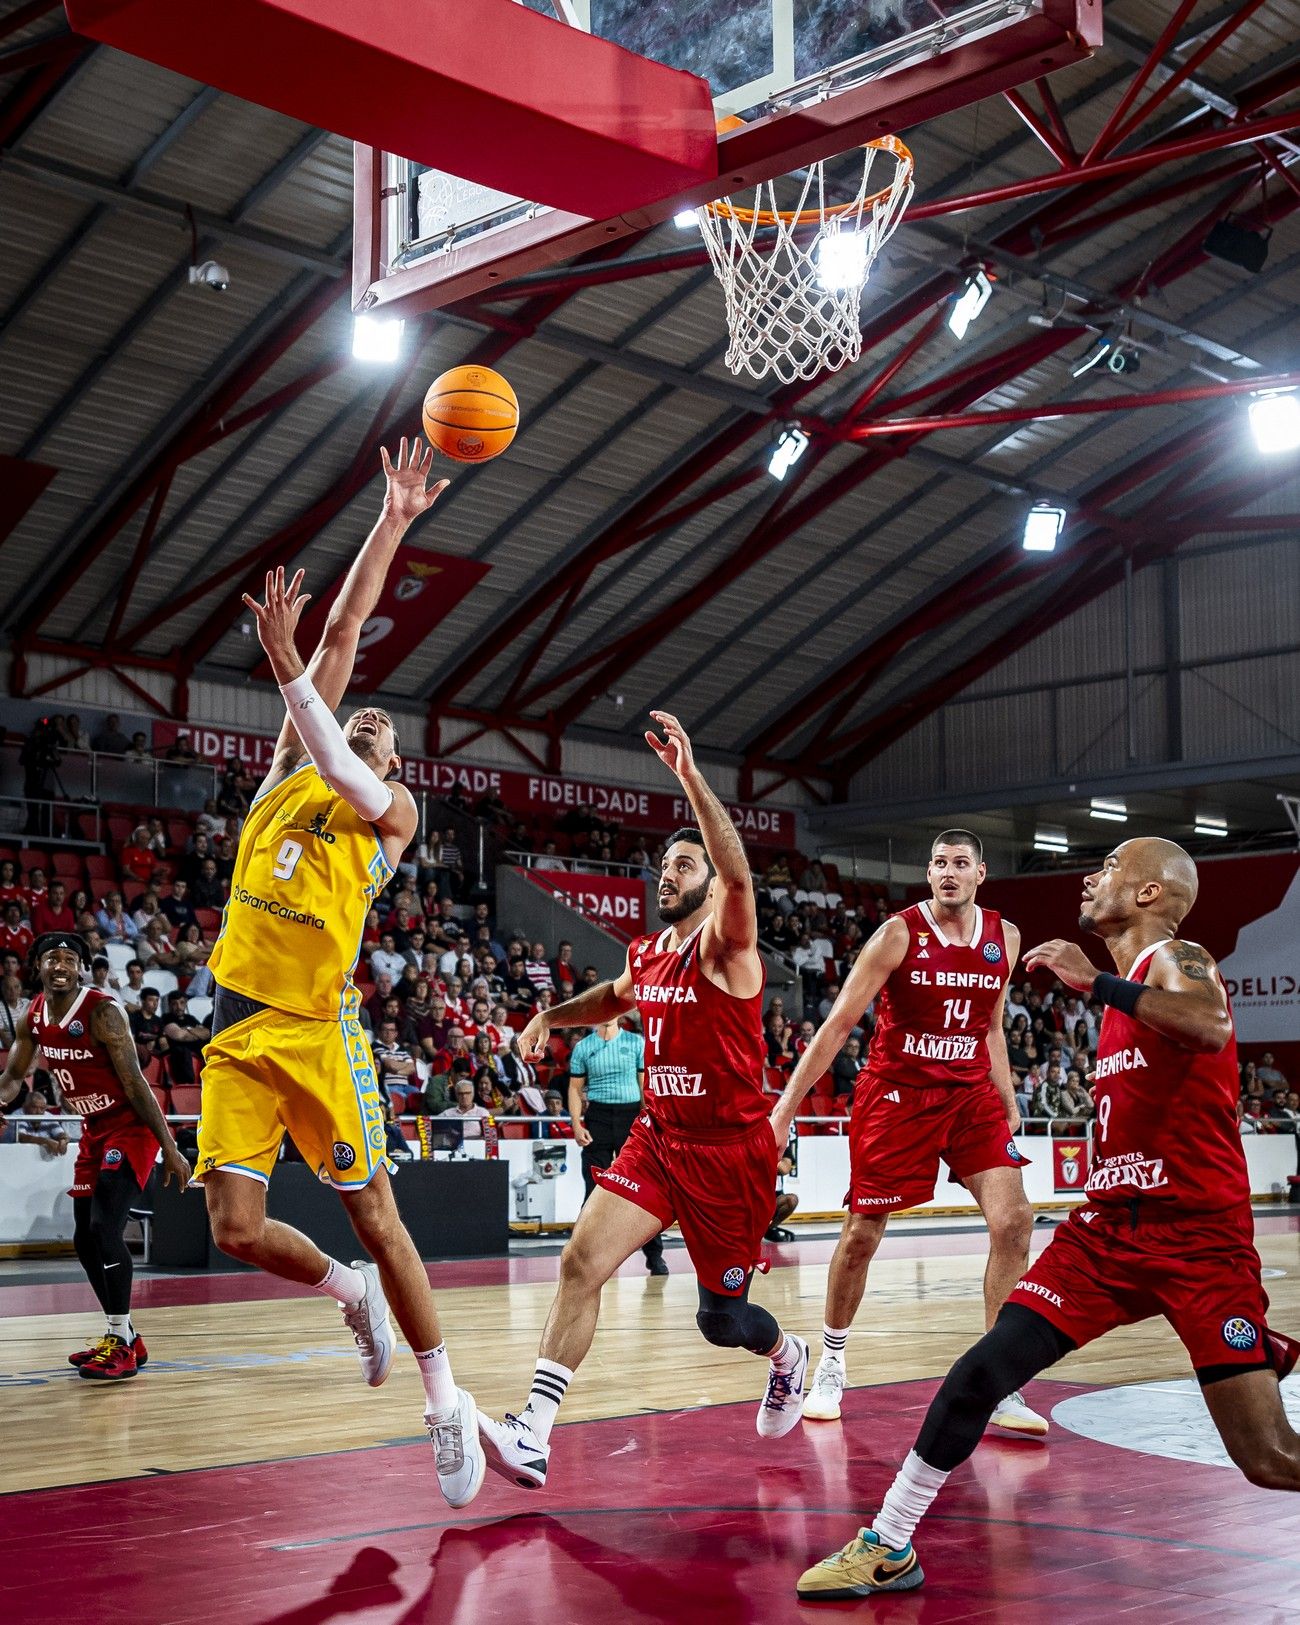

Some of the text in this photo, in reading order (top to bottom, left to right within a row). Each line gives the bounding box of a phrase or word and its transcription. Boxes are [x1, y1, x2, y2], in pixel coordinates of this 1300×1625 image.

[528, 778, 649, 816] FIDELIDADE
[273, 839, 304, 881] 9
[239, 889, 326, 930] GranCanaria
[642, 984, 698, 1004] BENFICA
[911, 971, 1001, 990] SL BENFICA
[1225, 975, 1300, 998] DELID
[943, 999, 972, 1029] 14
[648, 1016, 663, 1056] 4
[902, 1033, 979, 1061] RAMIREZ
[43, 1045, 94, 1061] BENFICA
[1095, 1047, 1149, 1080] BENFICA
[53, 1068, 76, 1092] 19
[1099, 1094, 1111, 1143] 9
[857, 1194, 903, 1206] MONEYFLIX
